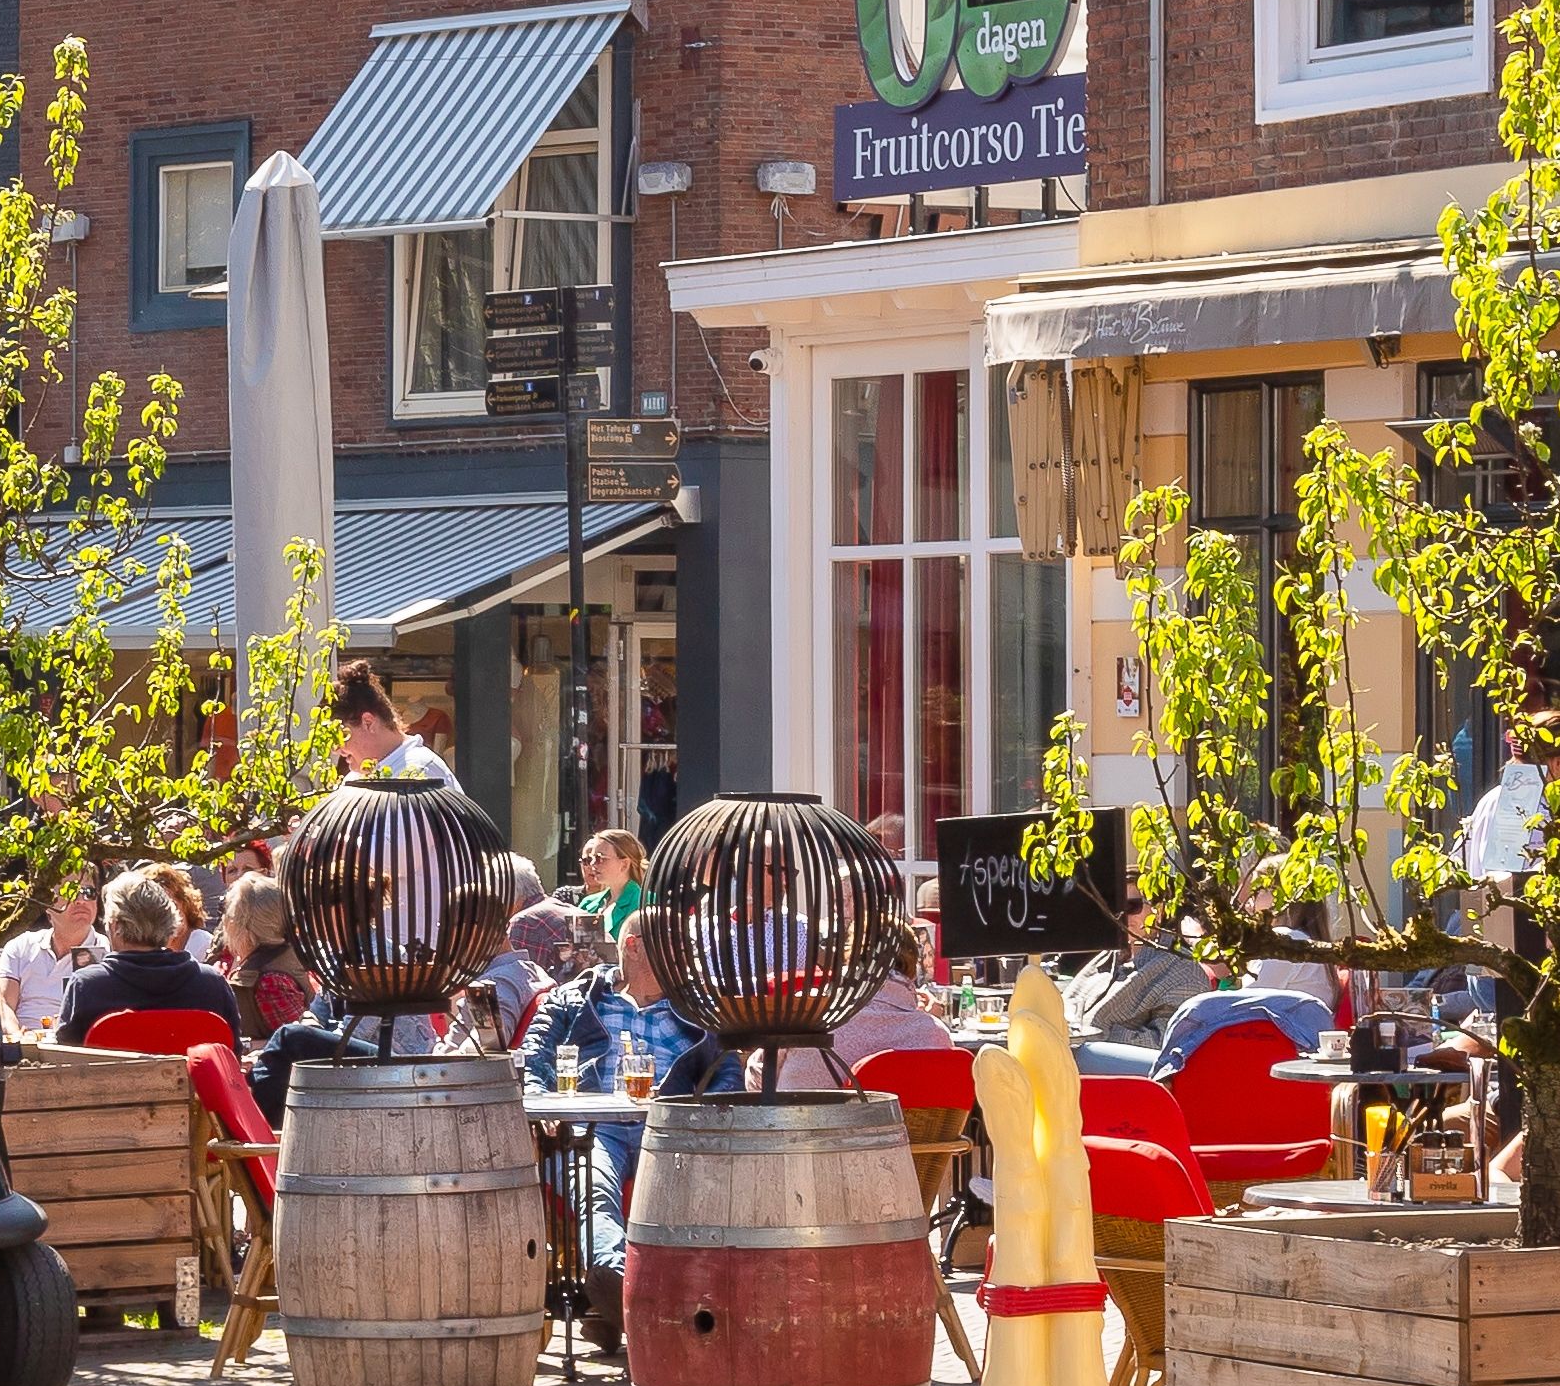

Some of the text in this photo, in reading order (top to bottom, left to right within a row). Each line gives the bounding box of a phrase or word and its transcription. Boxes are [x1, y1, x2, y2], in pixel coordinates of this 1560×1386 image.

[976, 13, 1047, 64] dagen
[853, 98, 1085, 179] Fruitcorso Tie
[592, 478, 619, 486] Station
